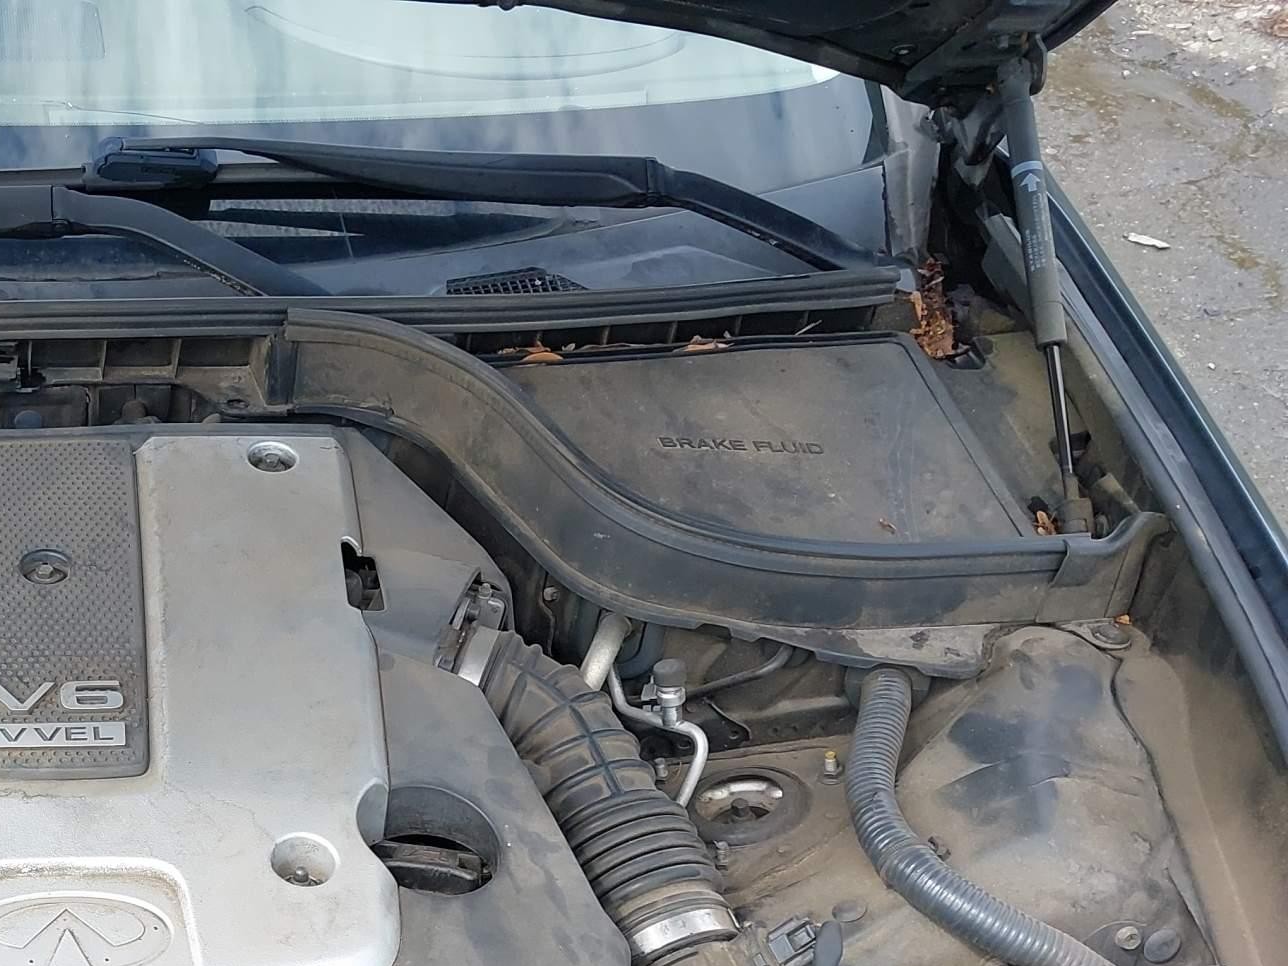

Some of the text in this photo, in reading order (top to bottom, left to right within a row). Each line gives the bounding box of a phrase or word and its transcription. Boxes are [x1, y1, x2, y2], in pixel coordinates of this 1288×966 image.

[656, 435, 825, 455] BRAKE FLUID
[0, 726, 114, 742] VVEL
